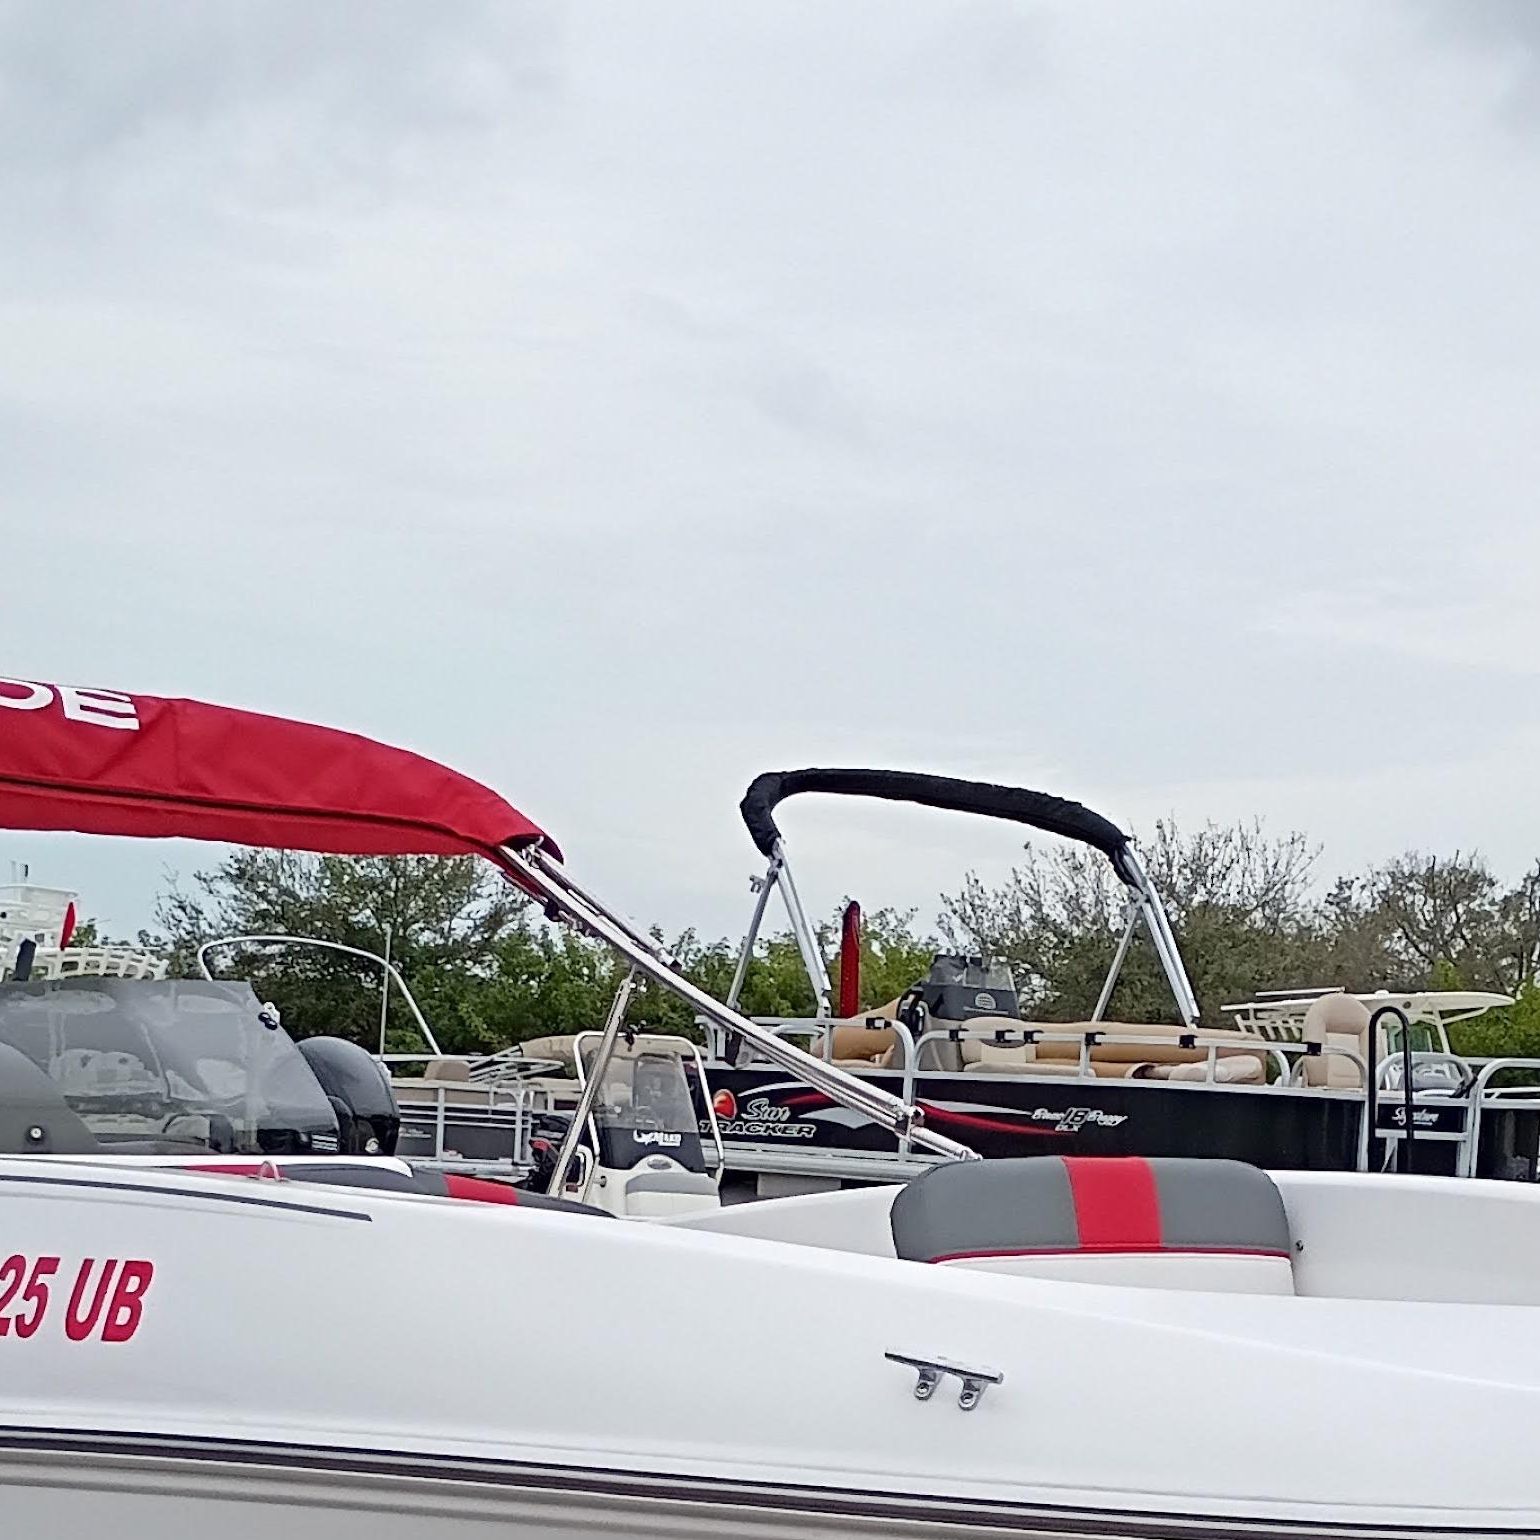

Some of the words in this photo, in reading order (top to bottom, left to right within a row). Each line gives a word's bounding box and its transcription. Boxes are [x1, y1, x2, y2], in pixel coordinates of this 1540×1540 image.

[741, 1097, 791, 1121] Sun
[699, 1120, 817, 1138] TRACKER
[65, 1258, 153, 1342] UB
